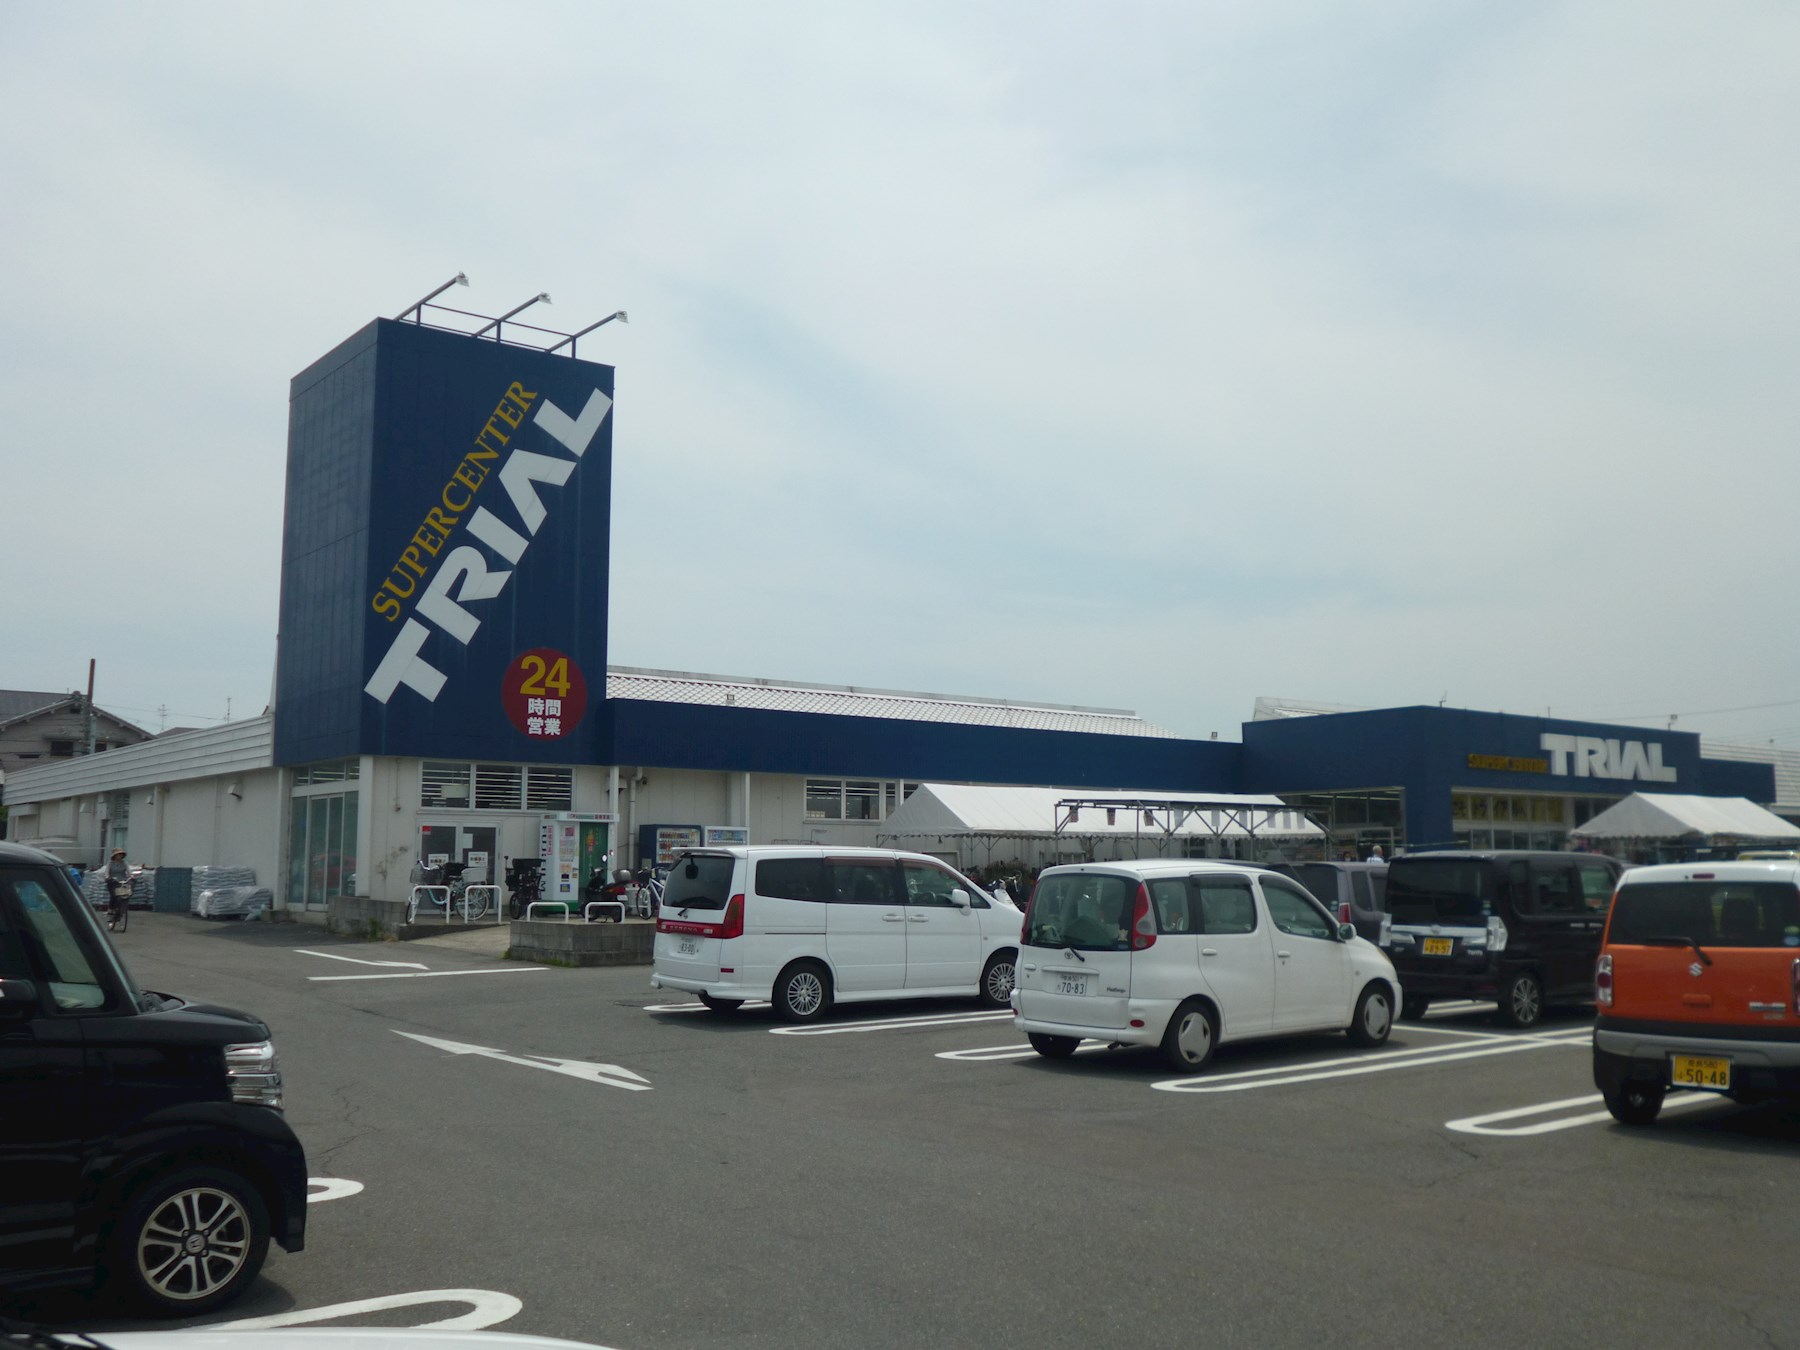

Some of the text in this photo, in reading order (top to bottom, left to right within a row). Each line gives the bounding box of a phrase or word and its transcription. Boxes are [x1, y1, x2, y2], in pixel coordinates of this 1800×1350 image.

[372, 381, 538, 622] SUPERCENTER
[364, 387, 614, 704] TRIAL
[520, 655, 571, 698] 24
[527, 717, 561, 736] 営業
[528, 698, 562, 717] 時間
[1541, 733, 1677, 782] TRIAL
[1685, 1068, 1727, 1086] 50-48
